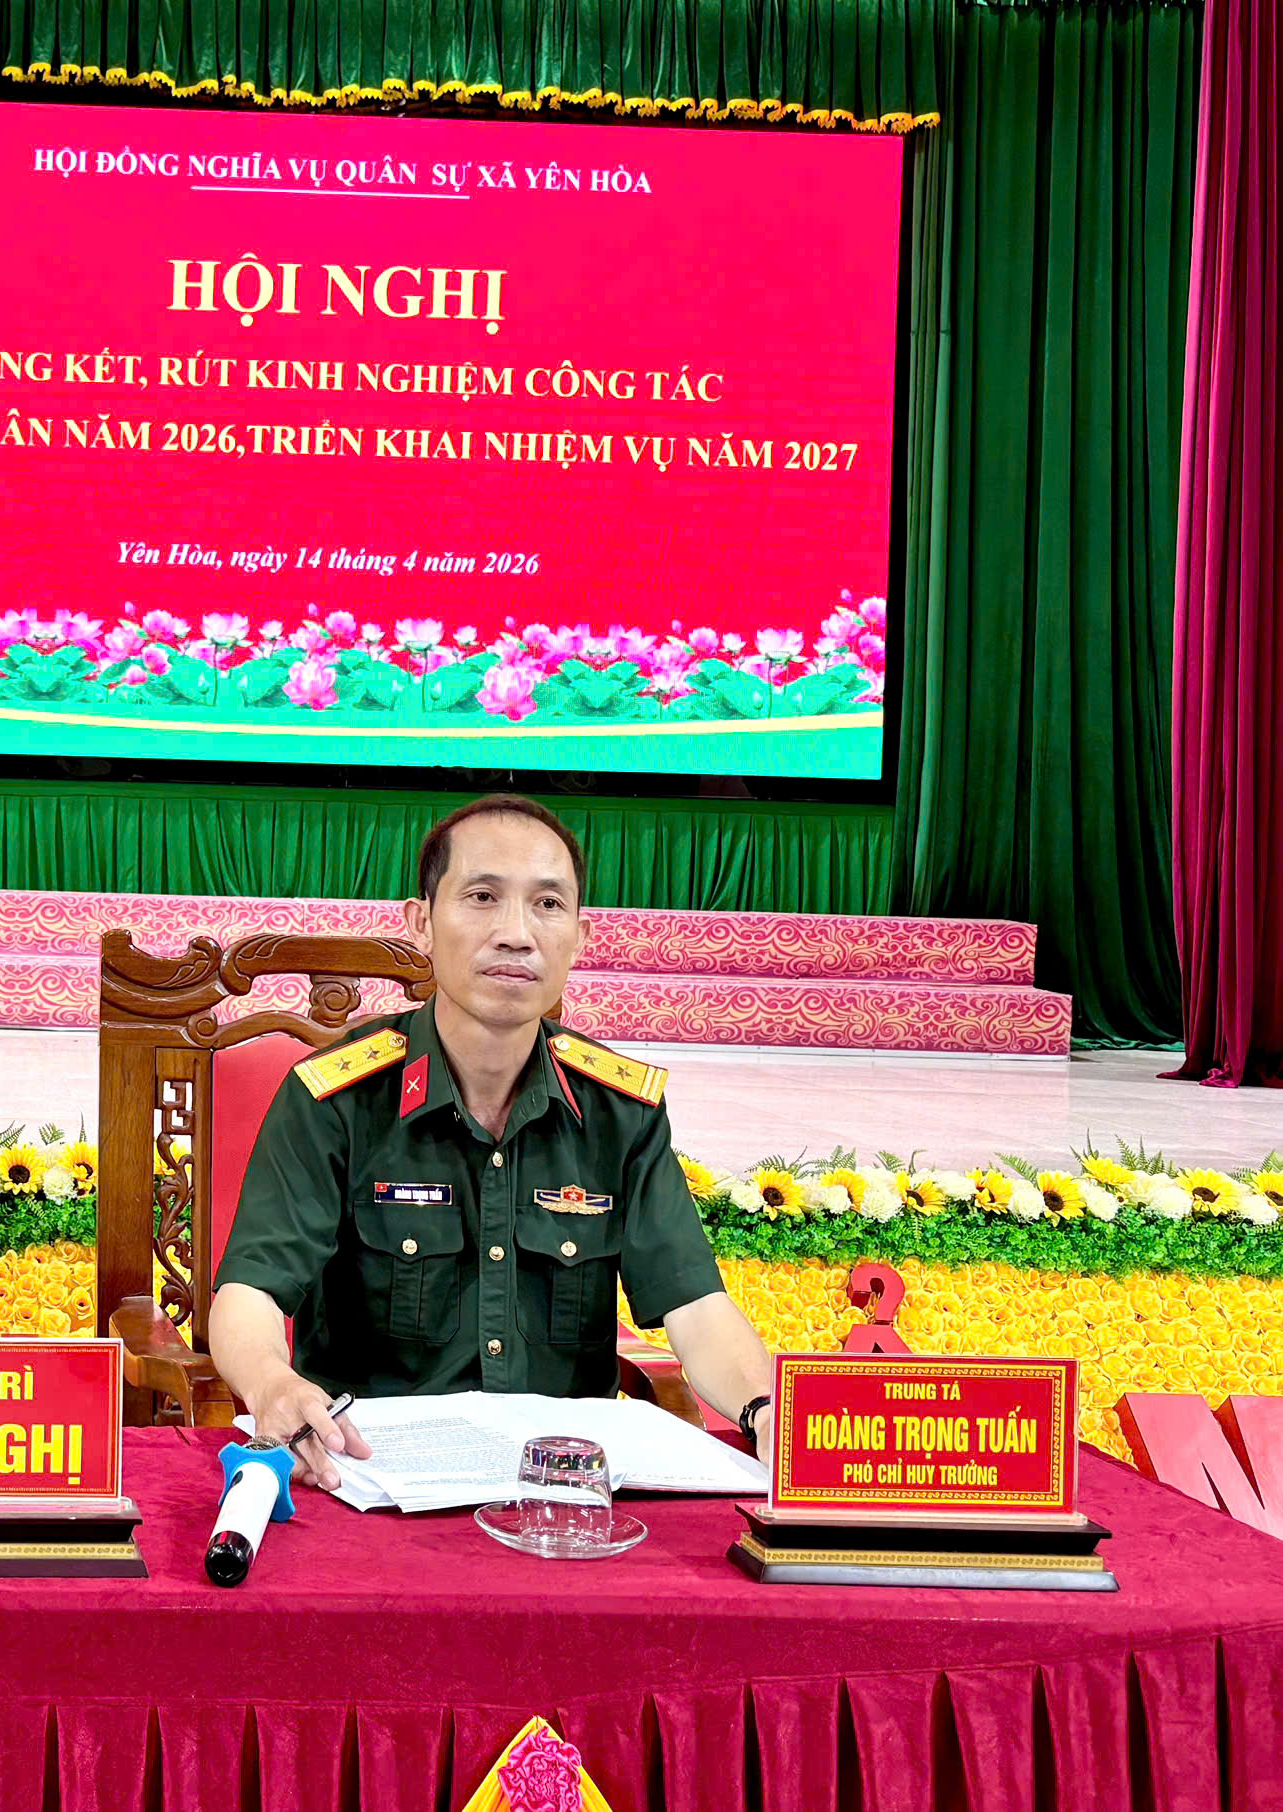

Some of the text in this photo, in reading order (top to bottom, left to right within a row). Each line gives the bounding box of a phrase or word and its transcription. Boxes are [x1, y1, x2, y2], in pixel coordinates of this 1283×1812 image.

[34, 146, 652, 194] HỘI ĐỒNG NGHĨA VỤ QUÂN SỰ XÃ YÊN HÒA
[167, 252, 508, 335] HỘI NGHỊ
[64, 347, 148, 389] KẾT,
[158, 349, 238, 387] RÚT
[247, 359, 344, 391] KINH
[356, 361, 514, 402] NGHIỆM
[524, 359, 636, 399] CÔNG
[645, 365, 723, 402] TÁC
[63, 413, 152, 450] NĂM
[375, 428, 473, 460] KHAI
[484, 429, 614, 470] NHIỆM
[623, 435, 676, 473] VỤ
[687, 432, 774, 469] NĂM
[784, 441, 858, 471] 2027
[118, 541, 539, 577] Yên Hòa, ngày 14 tháng 4 năm 2026
[883, 1380, 961, 1401] TRUNG TÁ
[806, 1405, 1037, 1460] HOÀNG TRỌNG TUẤN
[843, 1457, 998, 1486] PHÓ CHỈ HUY TRƯỞNG
